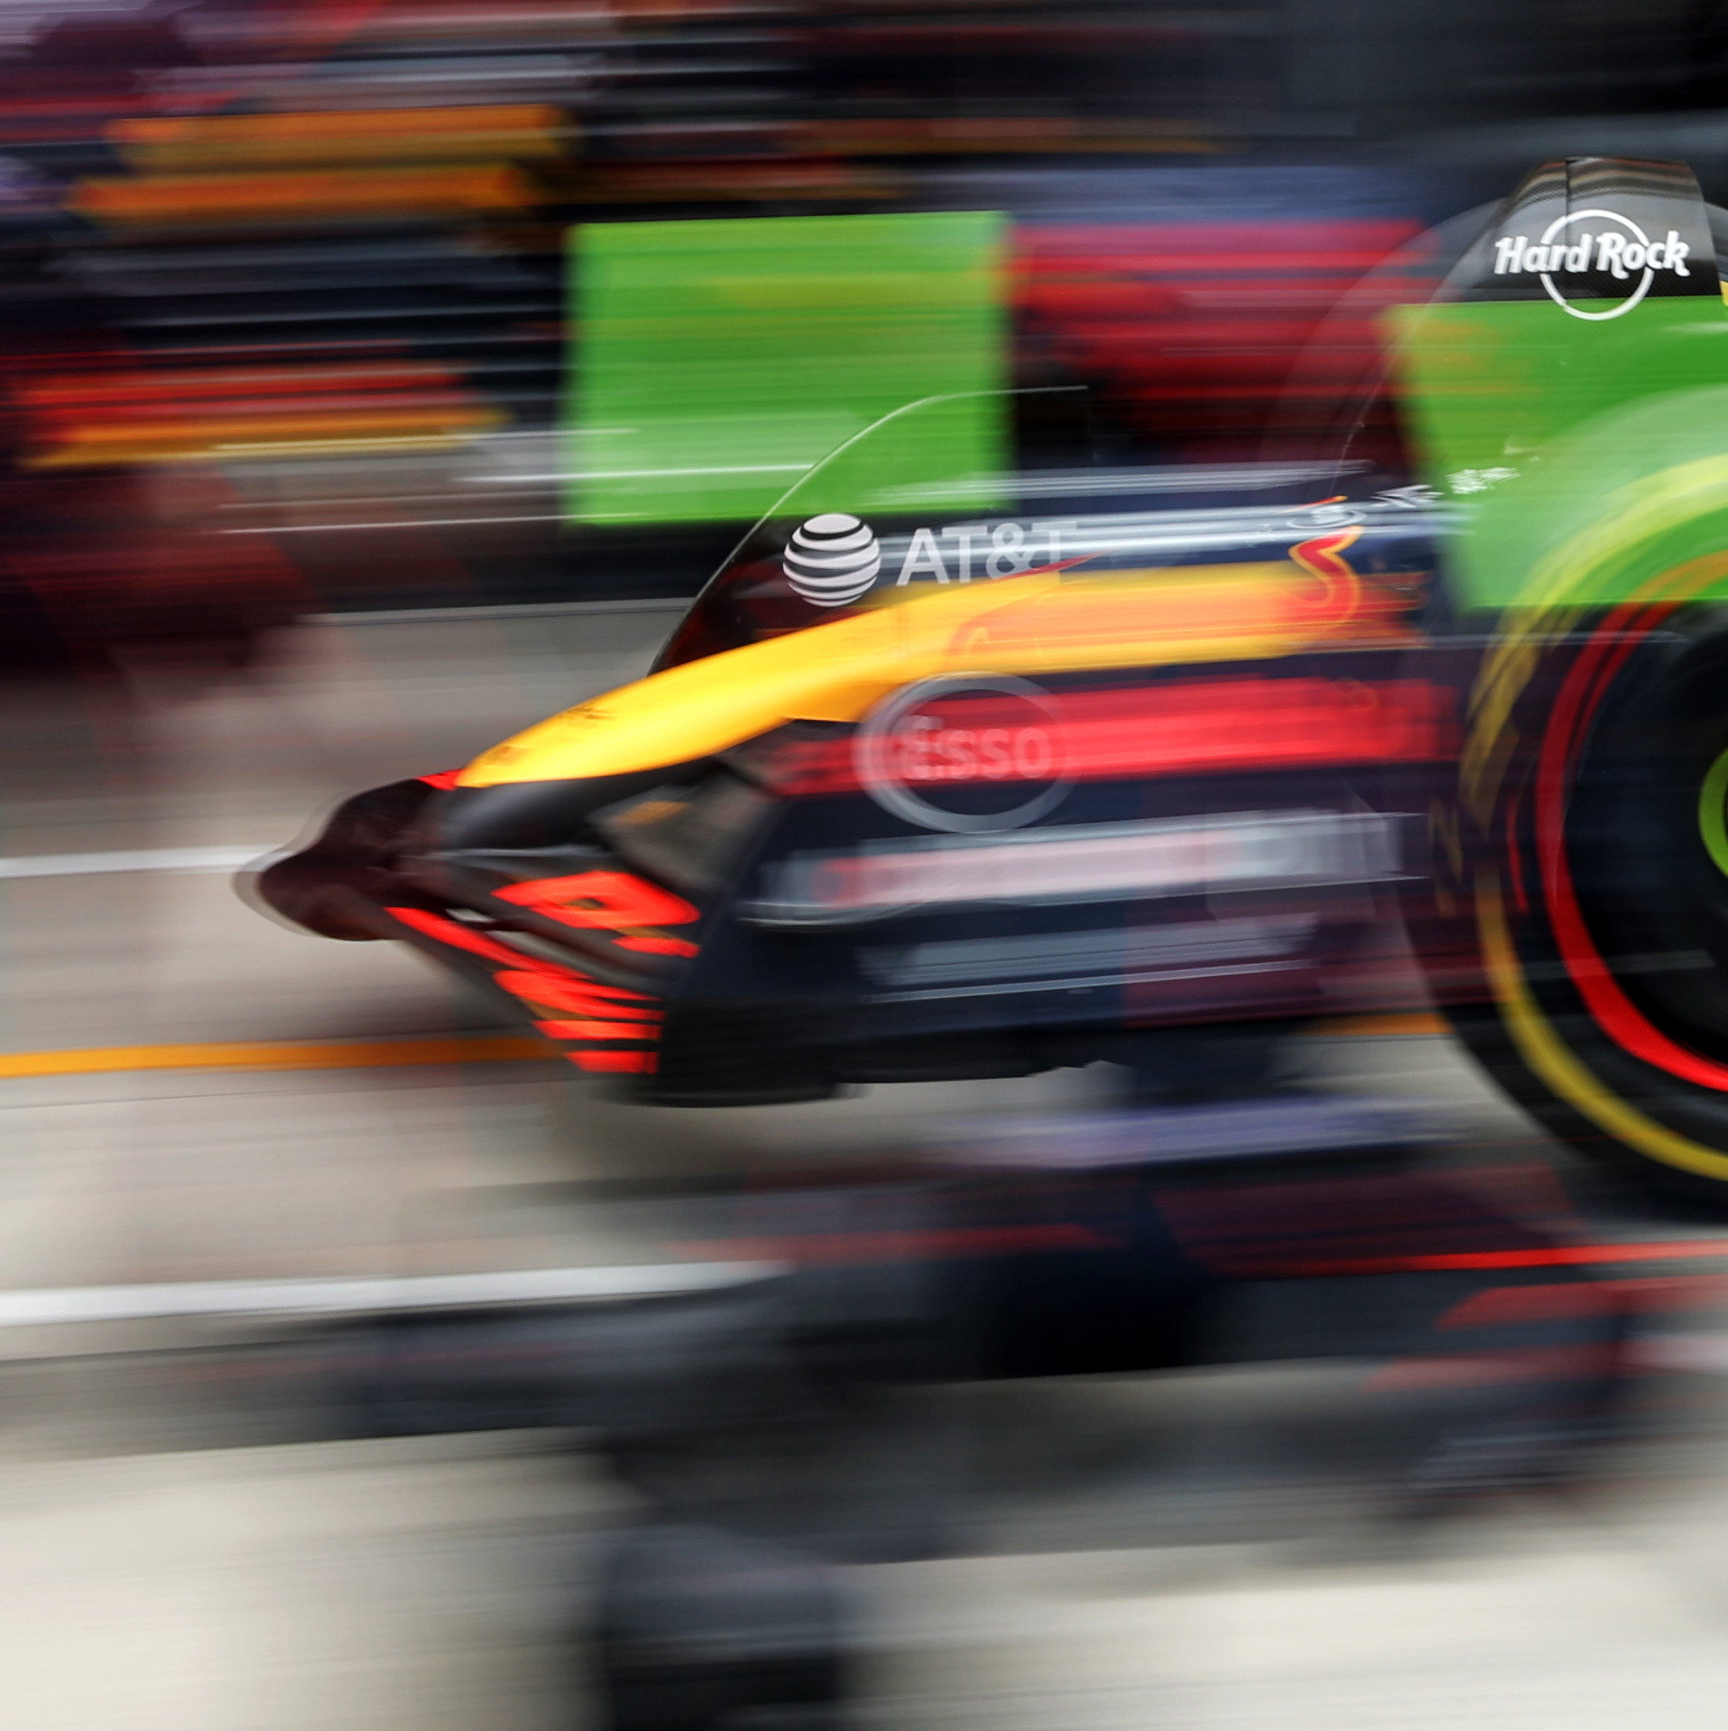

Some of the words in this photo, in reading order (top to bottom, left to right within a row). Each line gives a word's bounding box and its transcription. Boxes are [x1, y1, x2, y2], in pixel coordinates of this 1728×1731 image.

[1493, 233, 1593, 275] Hard
[1596, 230, 1691, 280] Rock
[896, 522, 1078, 587] AT&T
